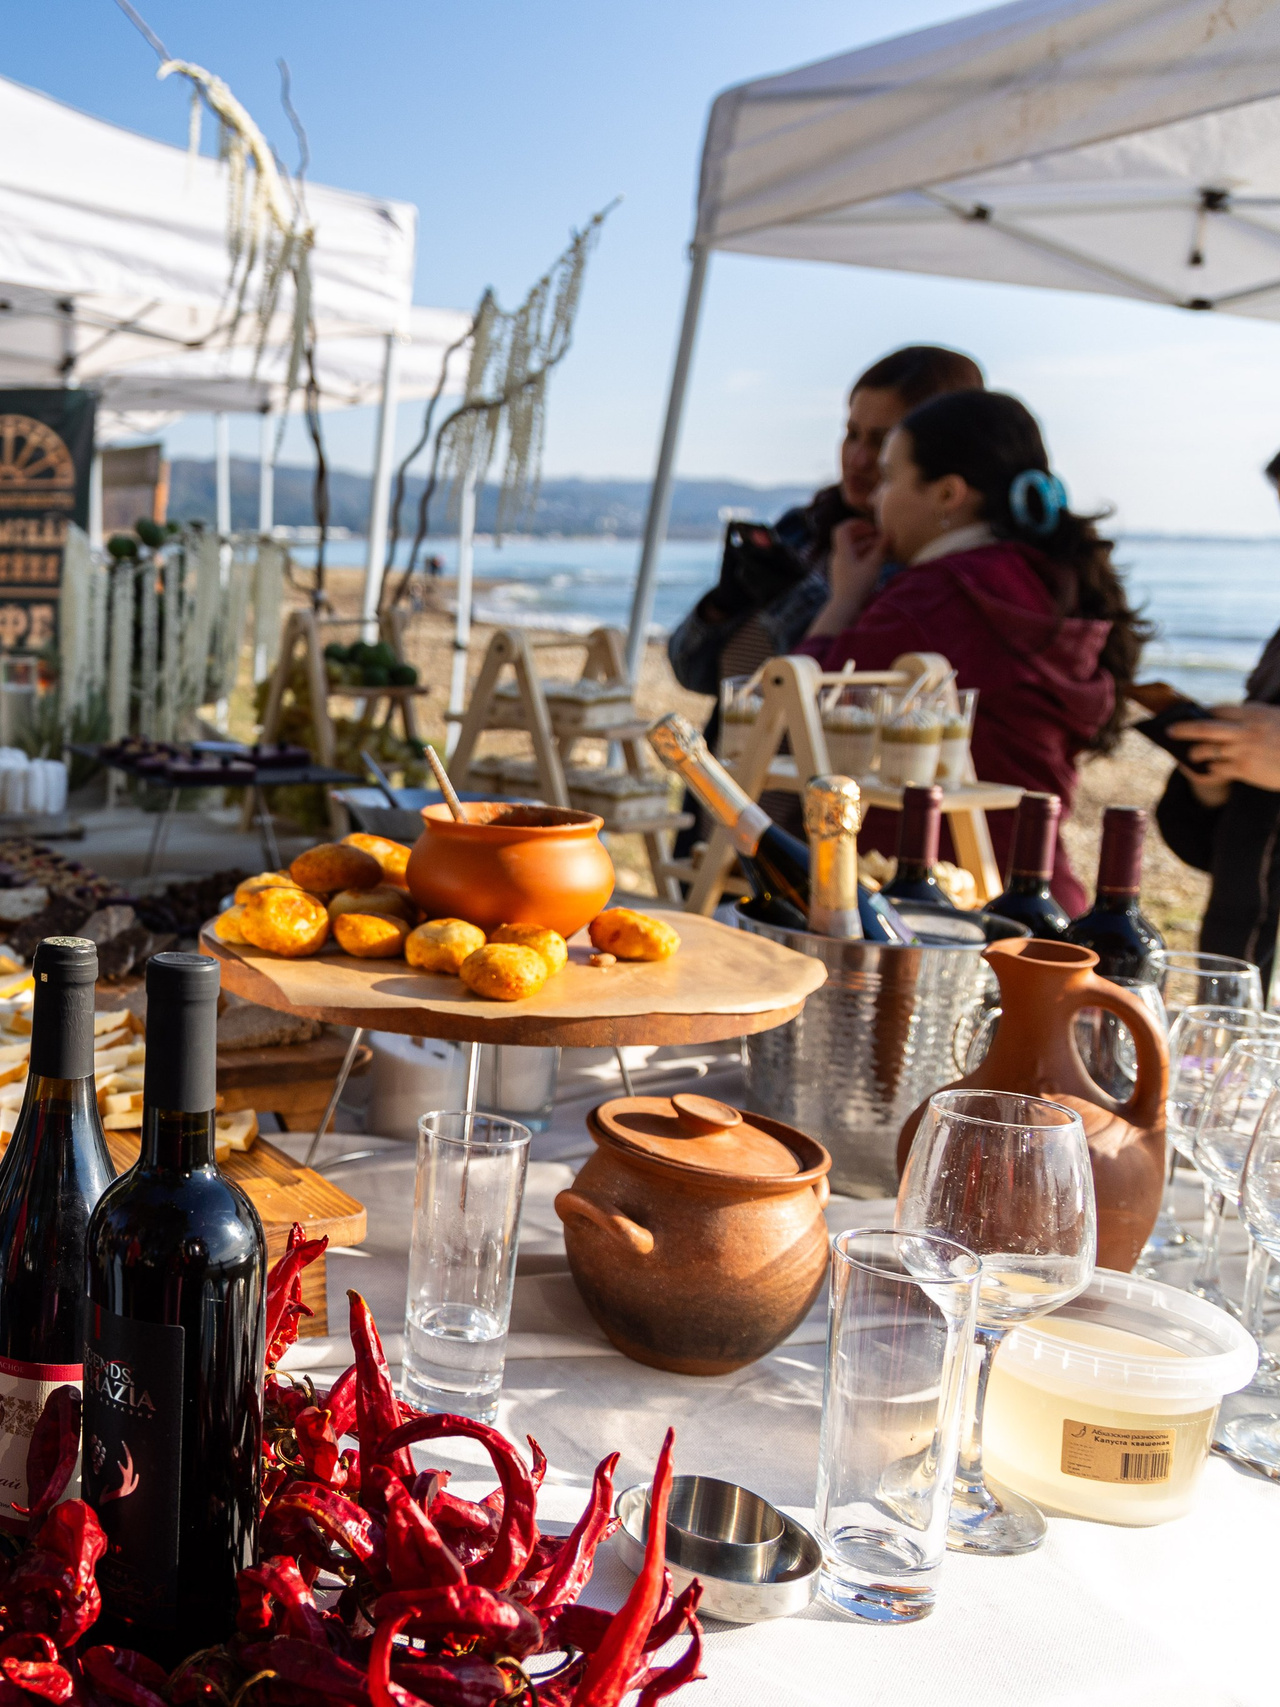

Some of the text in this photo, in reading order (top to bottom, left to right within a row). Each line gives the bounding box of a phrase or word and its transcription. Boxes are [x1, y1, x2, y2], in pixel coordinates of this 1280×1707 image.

[1091, 1428, 1169, 1441] Абхазские разносолы
[1094, 1436, 1128, 1446] Капуста
